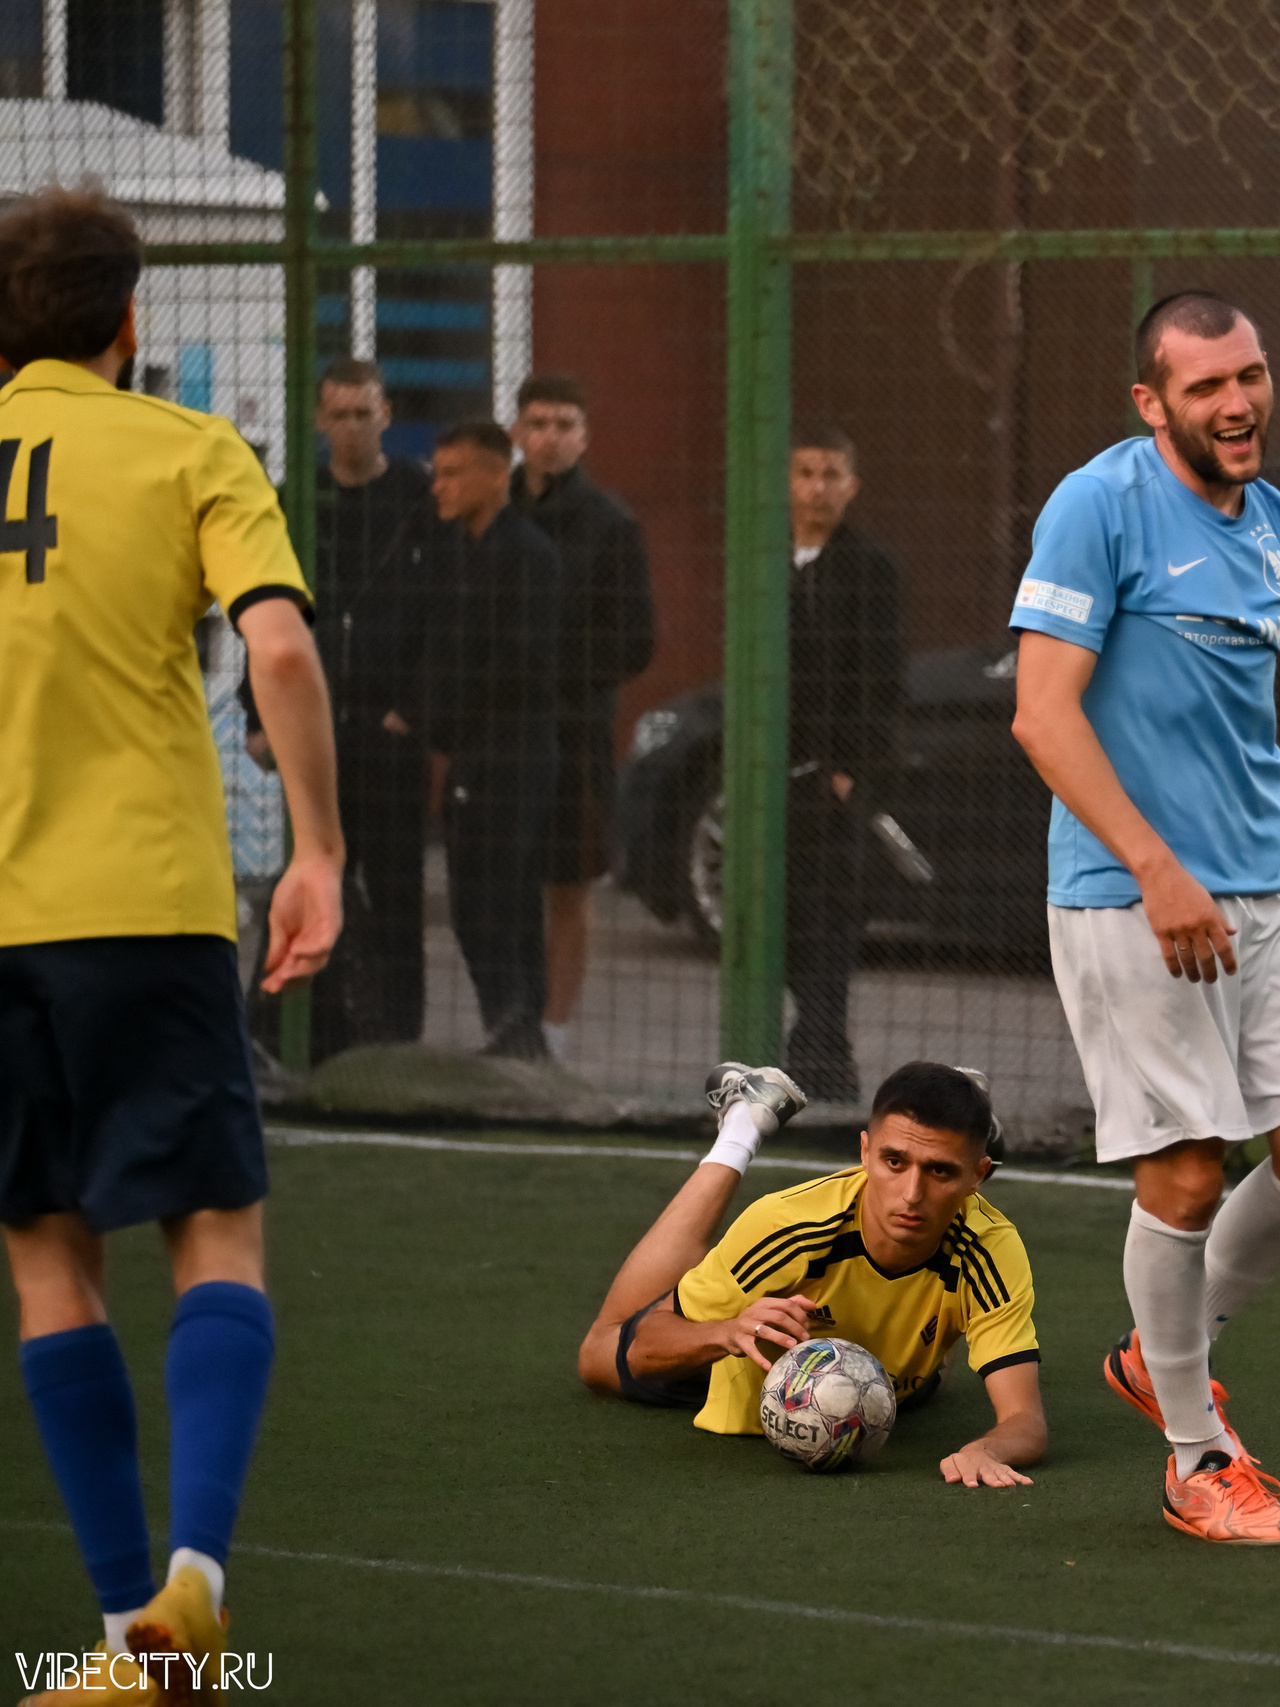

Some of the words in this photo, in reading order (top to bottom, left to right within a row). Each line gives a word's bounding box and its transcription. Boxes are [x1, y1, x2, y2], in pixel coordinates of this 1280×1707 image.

[0, 431, 58, 584] 4
[1037, 597, 1085, 618] RESPECT
[1041, 585, 1088, 606] УВАЖЕНИЕ
[762, 1405, 820, 1442] SELECT
